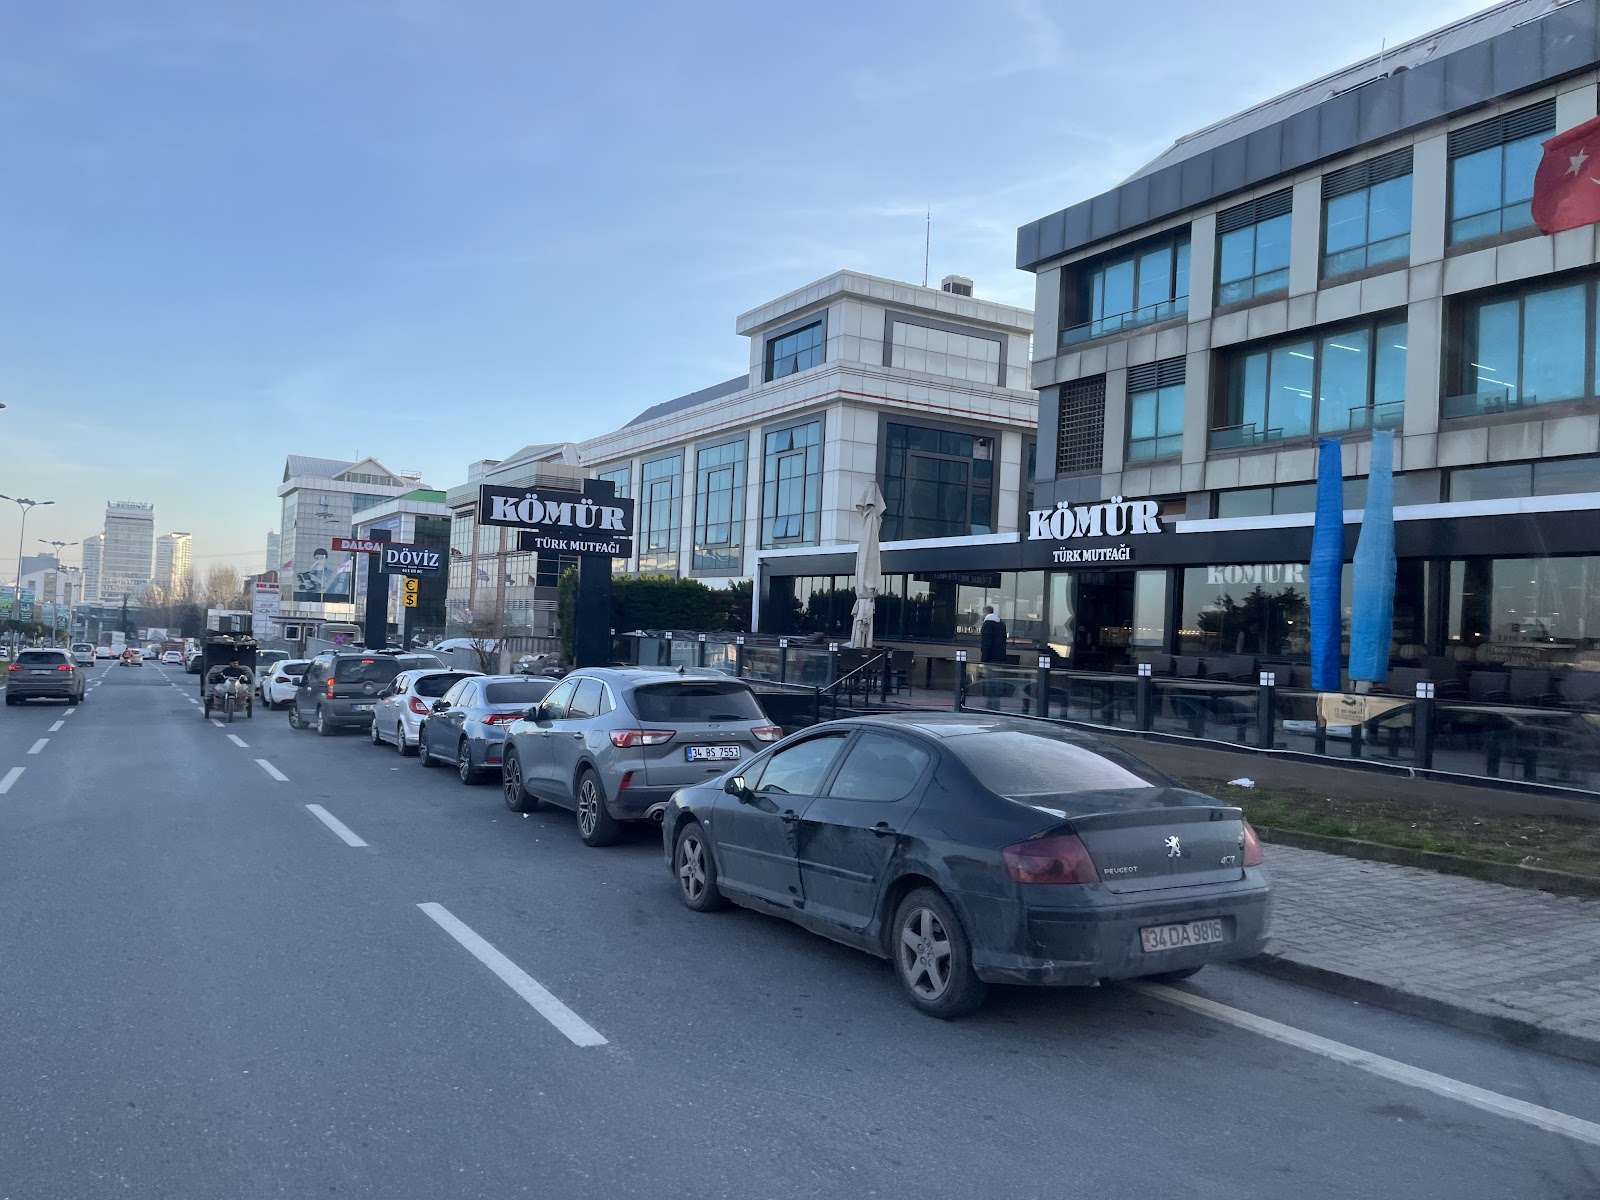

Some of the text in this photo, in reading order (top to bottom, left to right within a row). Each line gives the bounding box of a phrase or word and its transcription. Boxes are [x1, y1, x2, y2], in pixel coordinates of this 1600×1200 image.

[490, 493, 627, 531] KÖMÜR
[1028, 496, 1162, 541] KÖMÜR
[535, 536, 620, 554] TÜRK MUTFAĞI
[1053, 543, 1131, 562] TÜRK MUTFAĞI
[386, 548, 440, 567] DÖVİZ
[692, 747, 738, 757] 34 BS 7553
[1104, 865, 1138, 875] PEUGEOT
[1150, 921, 1221, 949] 34 DA 9816
